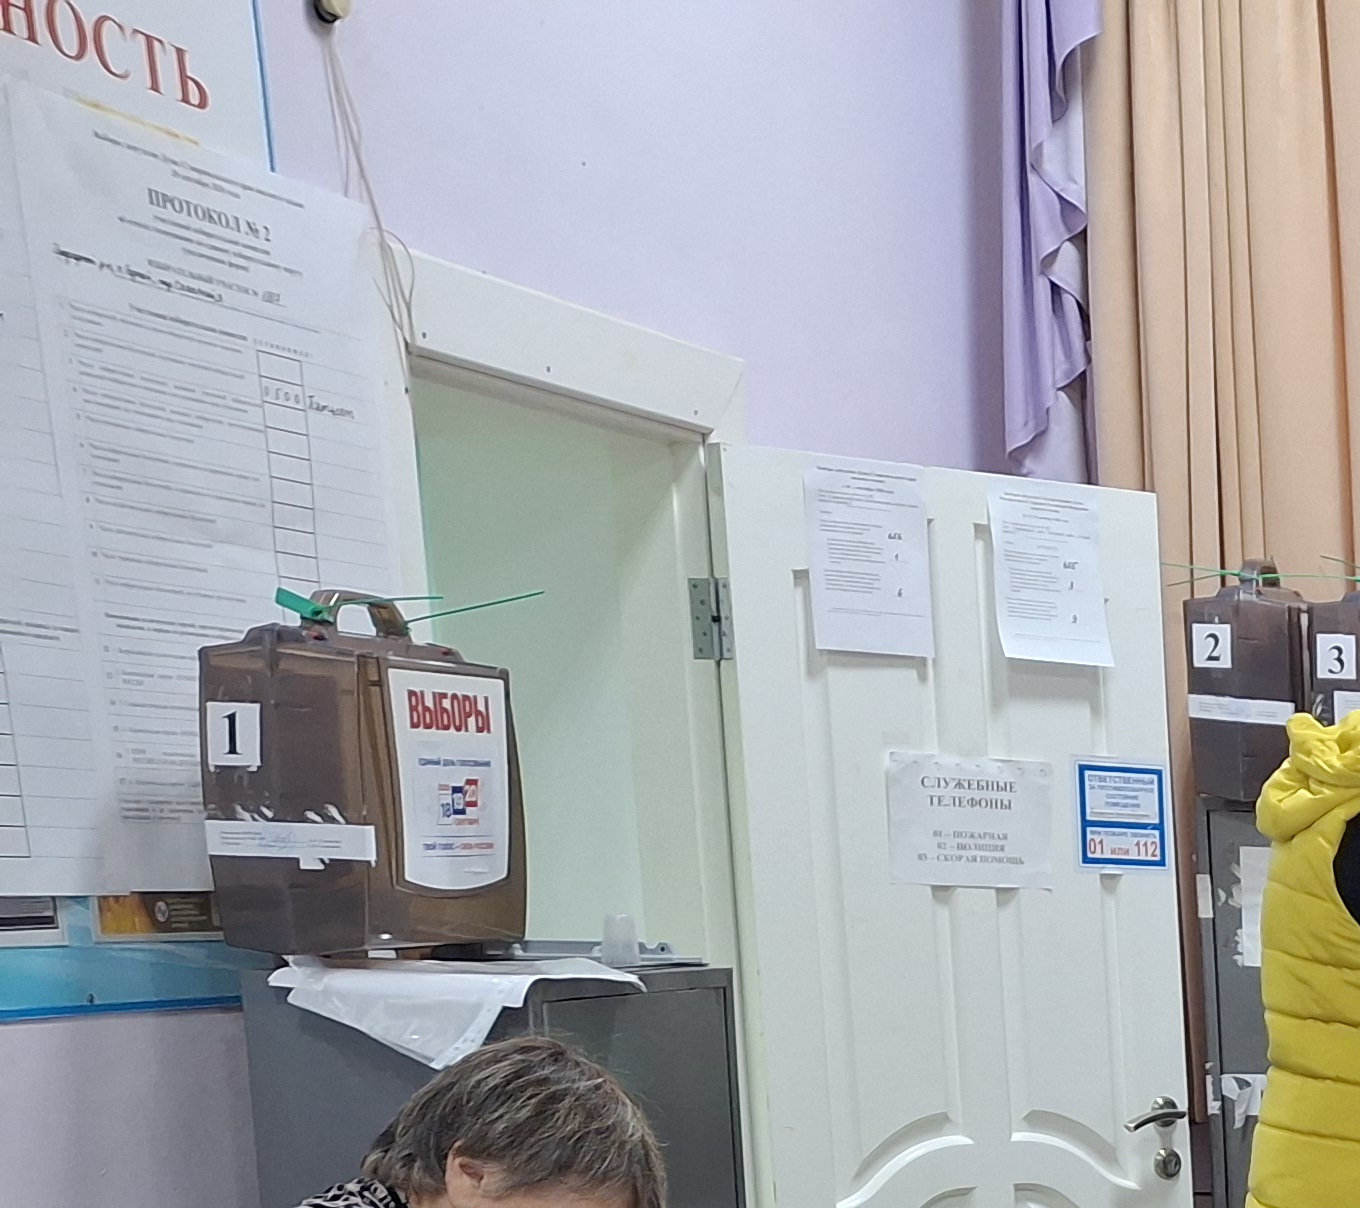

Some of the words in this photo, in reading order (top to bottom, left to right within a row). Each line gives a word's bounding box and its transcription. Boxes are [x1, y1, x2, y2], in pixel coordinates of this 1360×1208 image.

[147, 187, 240, 233] ПРОТОКОЛ
[264, 224, 271, 242] 2
[1204, 632, 1220, 662] 2
[1327, 644, 1345, 674] 3
[406, 689, 492, 734] ВЫБОРЫ
[222, 710, 243, 755] 1
[920, 776, 1018, 793] СЛУЖЕБНЫЕ
[928, 794, 1012, 810] ТЕЛЕФОНЫ
[952, 830, 1008, 840] ПОЖАРНАЯ
[1088, 838, 1104, 855] 01
[1134, 840, 1158, 857] 112
